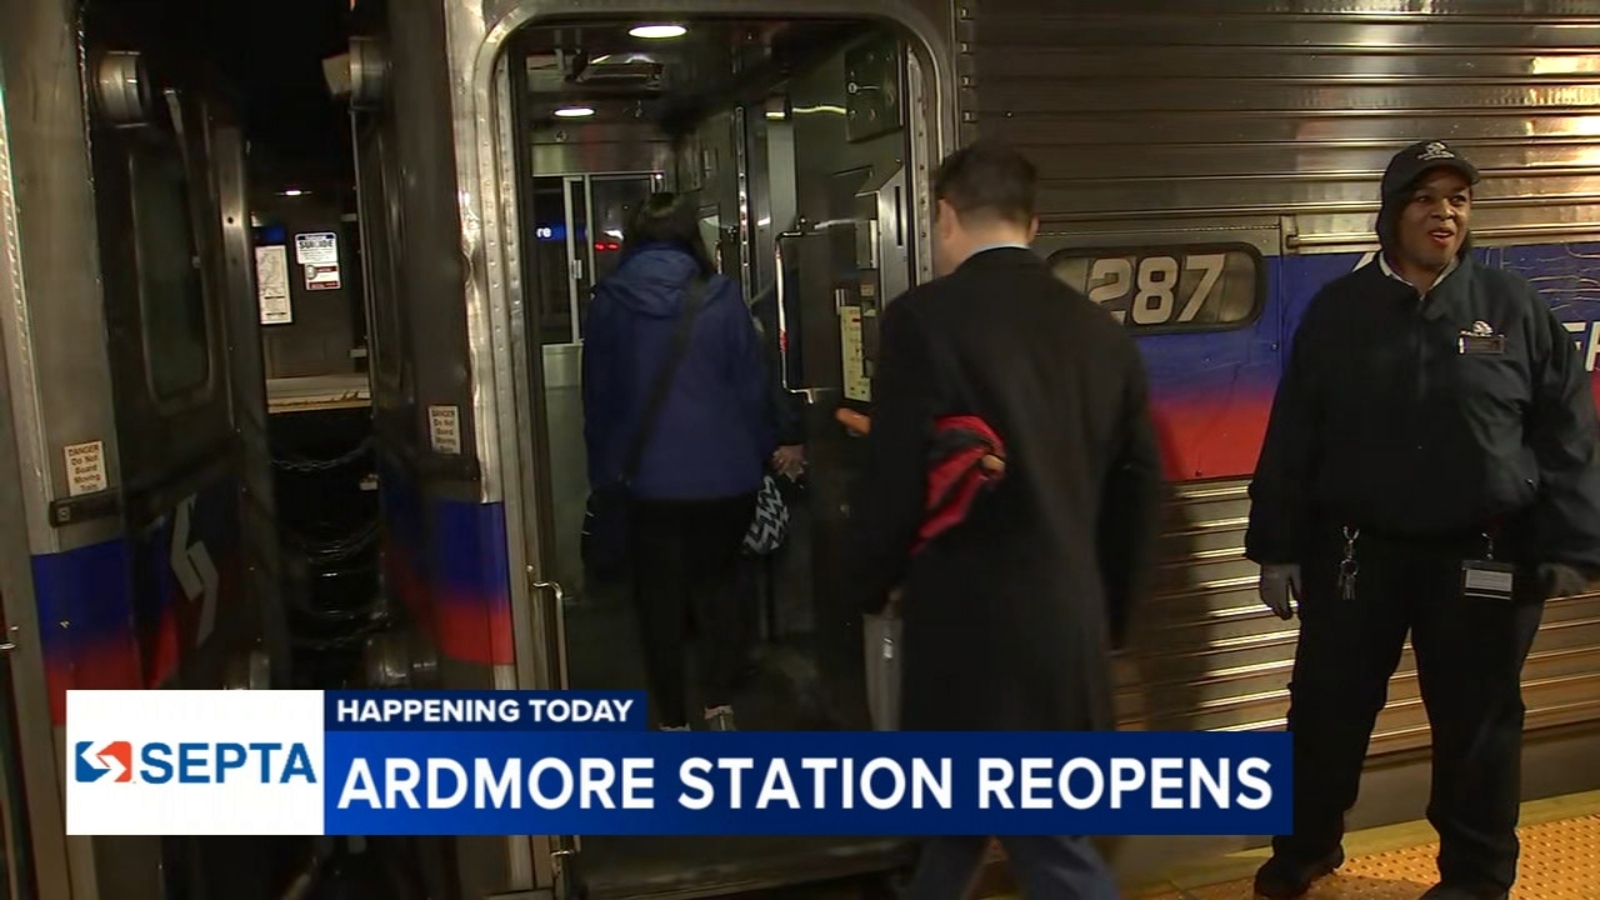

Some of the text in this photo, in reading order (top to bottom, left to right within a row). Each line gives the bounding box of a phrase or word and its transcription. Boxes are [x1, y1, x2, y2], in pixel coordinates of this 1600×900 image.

[1087, 254, 1226, 325] 287
[68, 444, 99, 456] DANGER
[71, 454, 98, 466] Do Not
